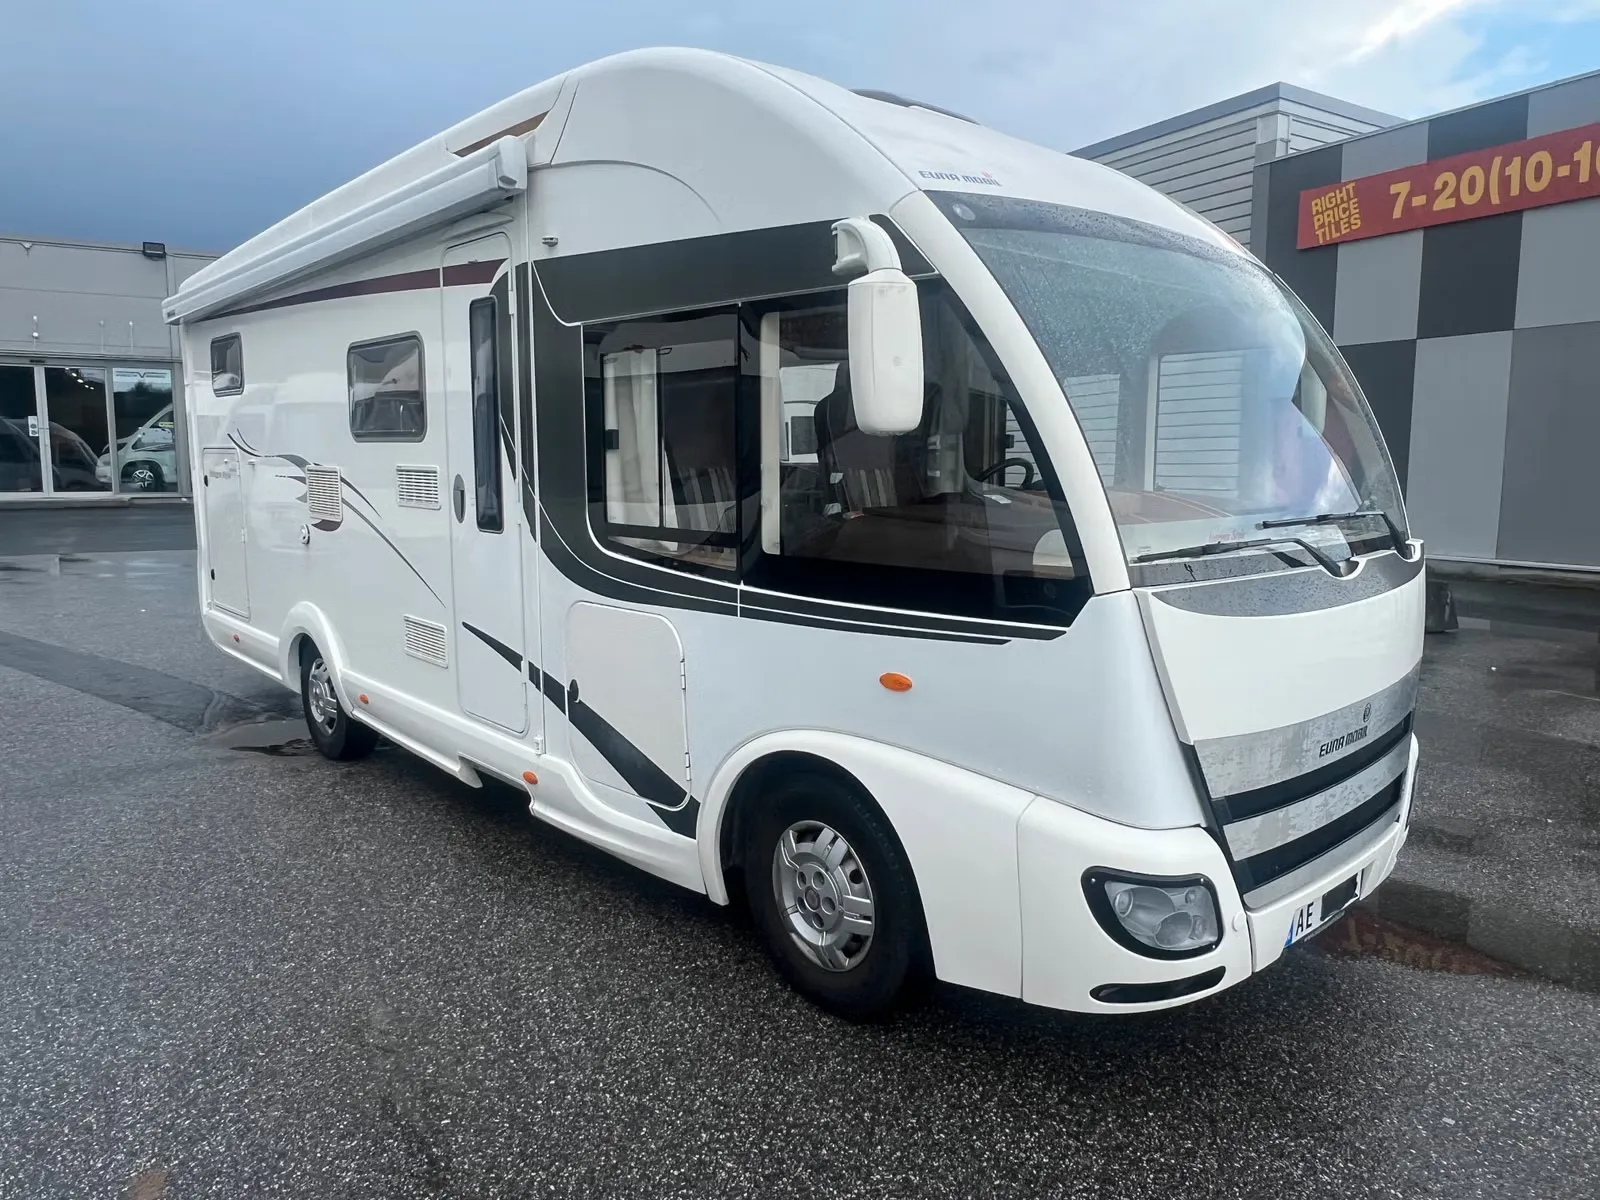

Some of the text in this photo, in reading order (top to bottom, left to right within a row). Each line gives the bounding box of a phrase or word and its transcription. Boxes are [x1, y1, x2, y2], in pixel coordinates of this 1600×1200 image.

[1389, 140, 1600, 220] 7-20(10-1
[1311, 182, 1356, 216] RIGHT
[1313, 198, 1360, 231] PRICE
[1315, 213, 1361, 244] TILES
[1295, 901, 1314, 937] AE
